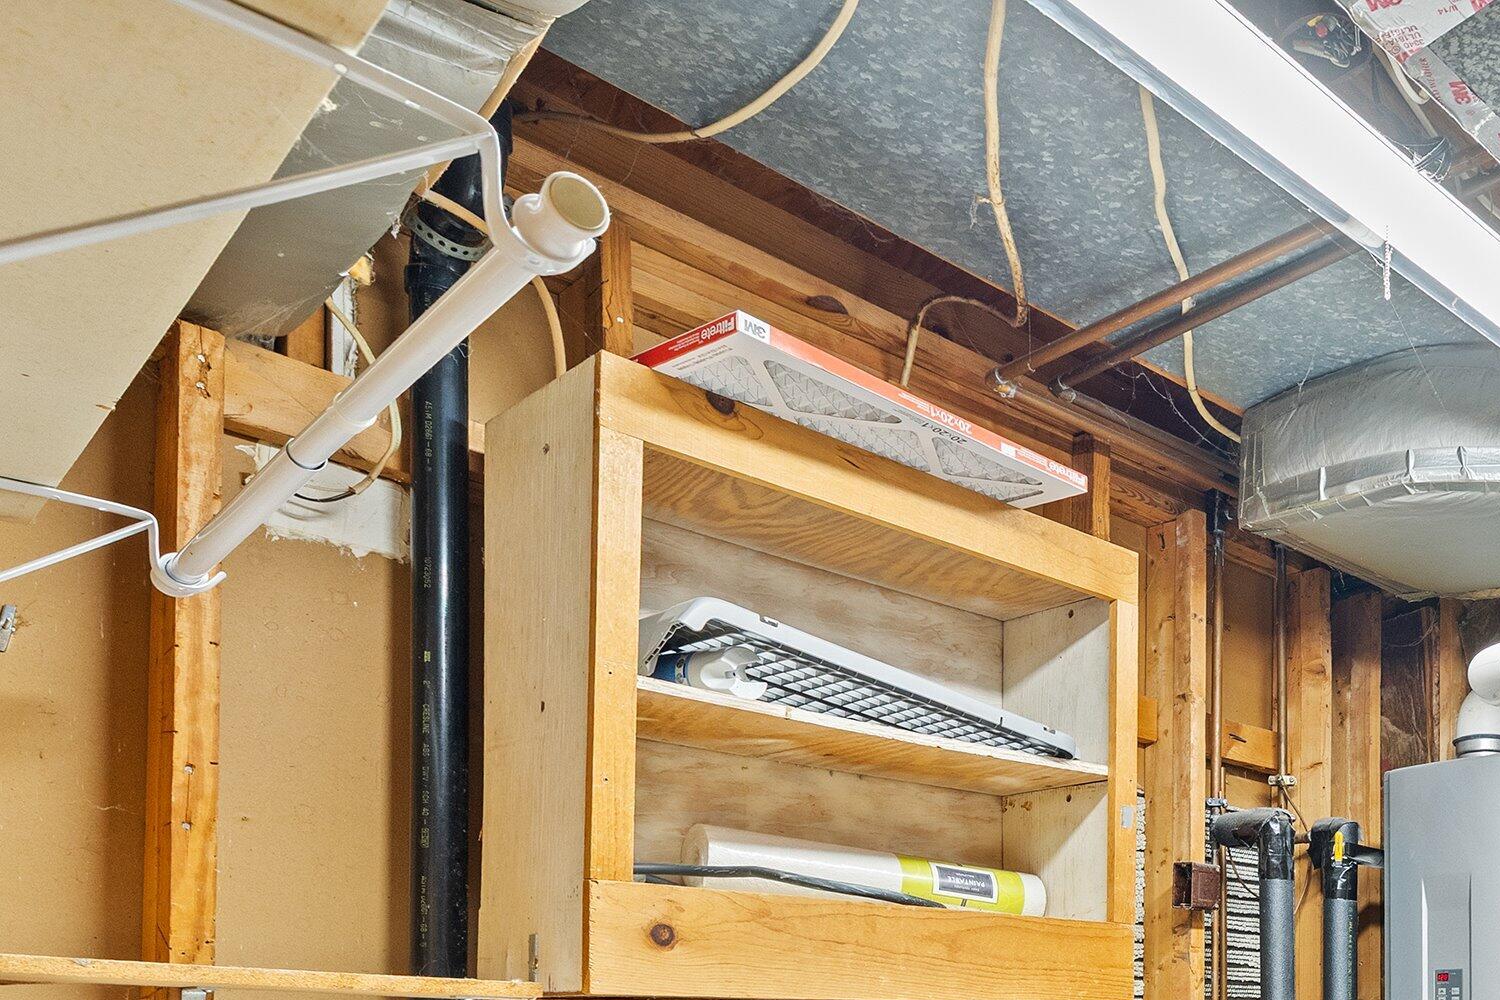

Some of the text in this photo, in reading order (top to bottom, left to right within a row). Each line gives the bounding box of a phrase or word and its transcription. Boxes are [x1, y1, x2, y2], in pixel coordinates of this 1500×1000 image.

[1449, 80, 1473, 106] 3M
[700, 316, 735, 339] Filtrete
[744, 318, 767, 339] 3M
